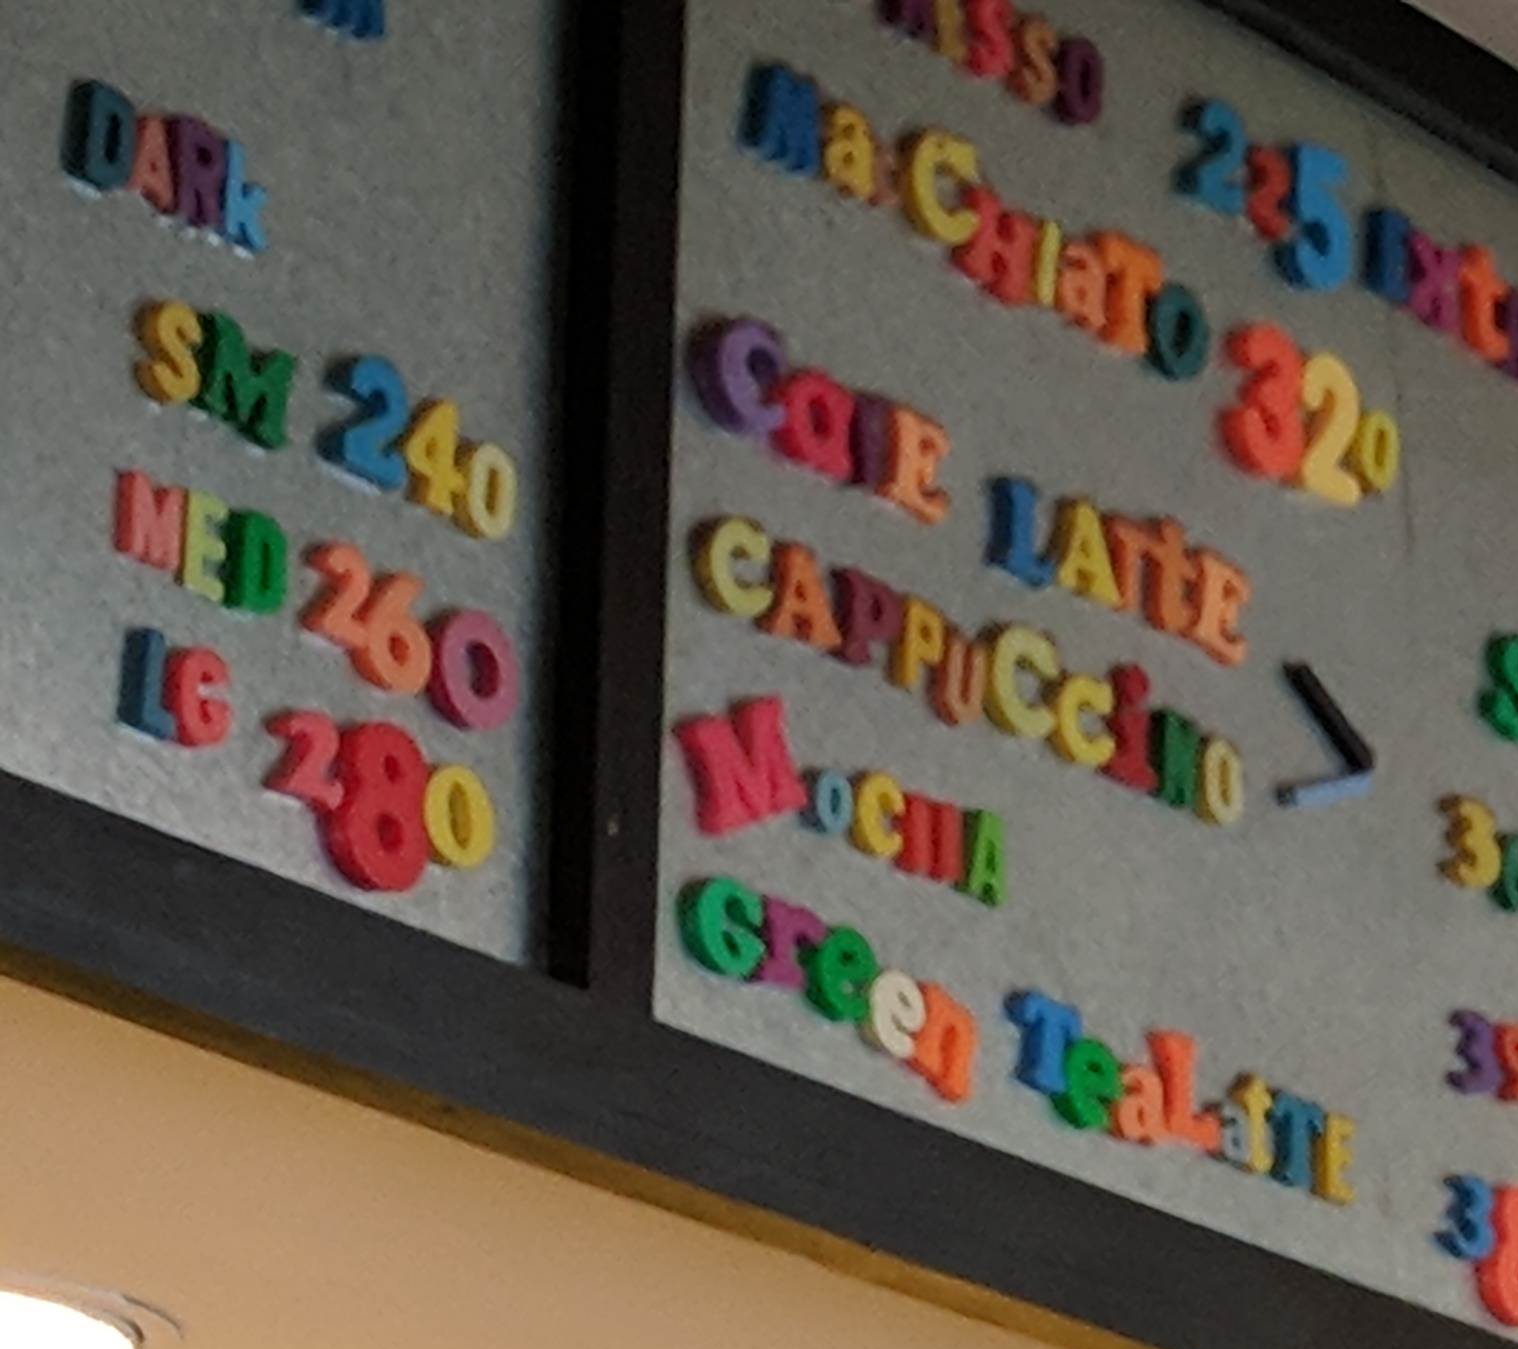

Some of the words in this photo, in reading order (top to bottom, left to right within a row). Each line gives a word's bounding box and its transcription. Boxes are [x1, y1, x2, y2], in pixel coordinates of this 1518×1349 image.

[135, 300, 298, 450] SM
[318, 354, 517, 540] 240
[1220, 322, 1398, 505] 320
[114, 470, 288, 616] MED
[302, 540, 518, 732] 260
[118, 627, 233, 746] LG
[265, 710, 495, 892] 280
